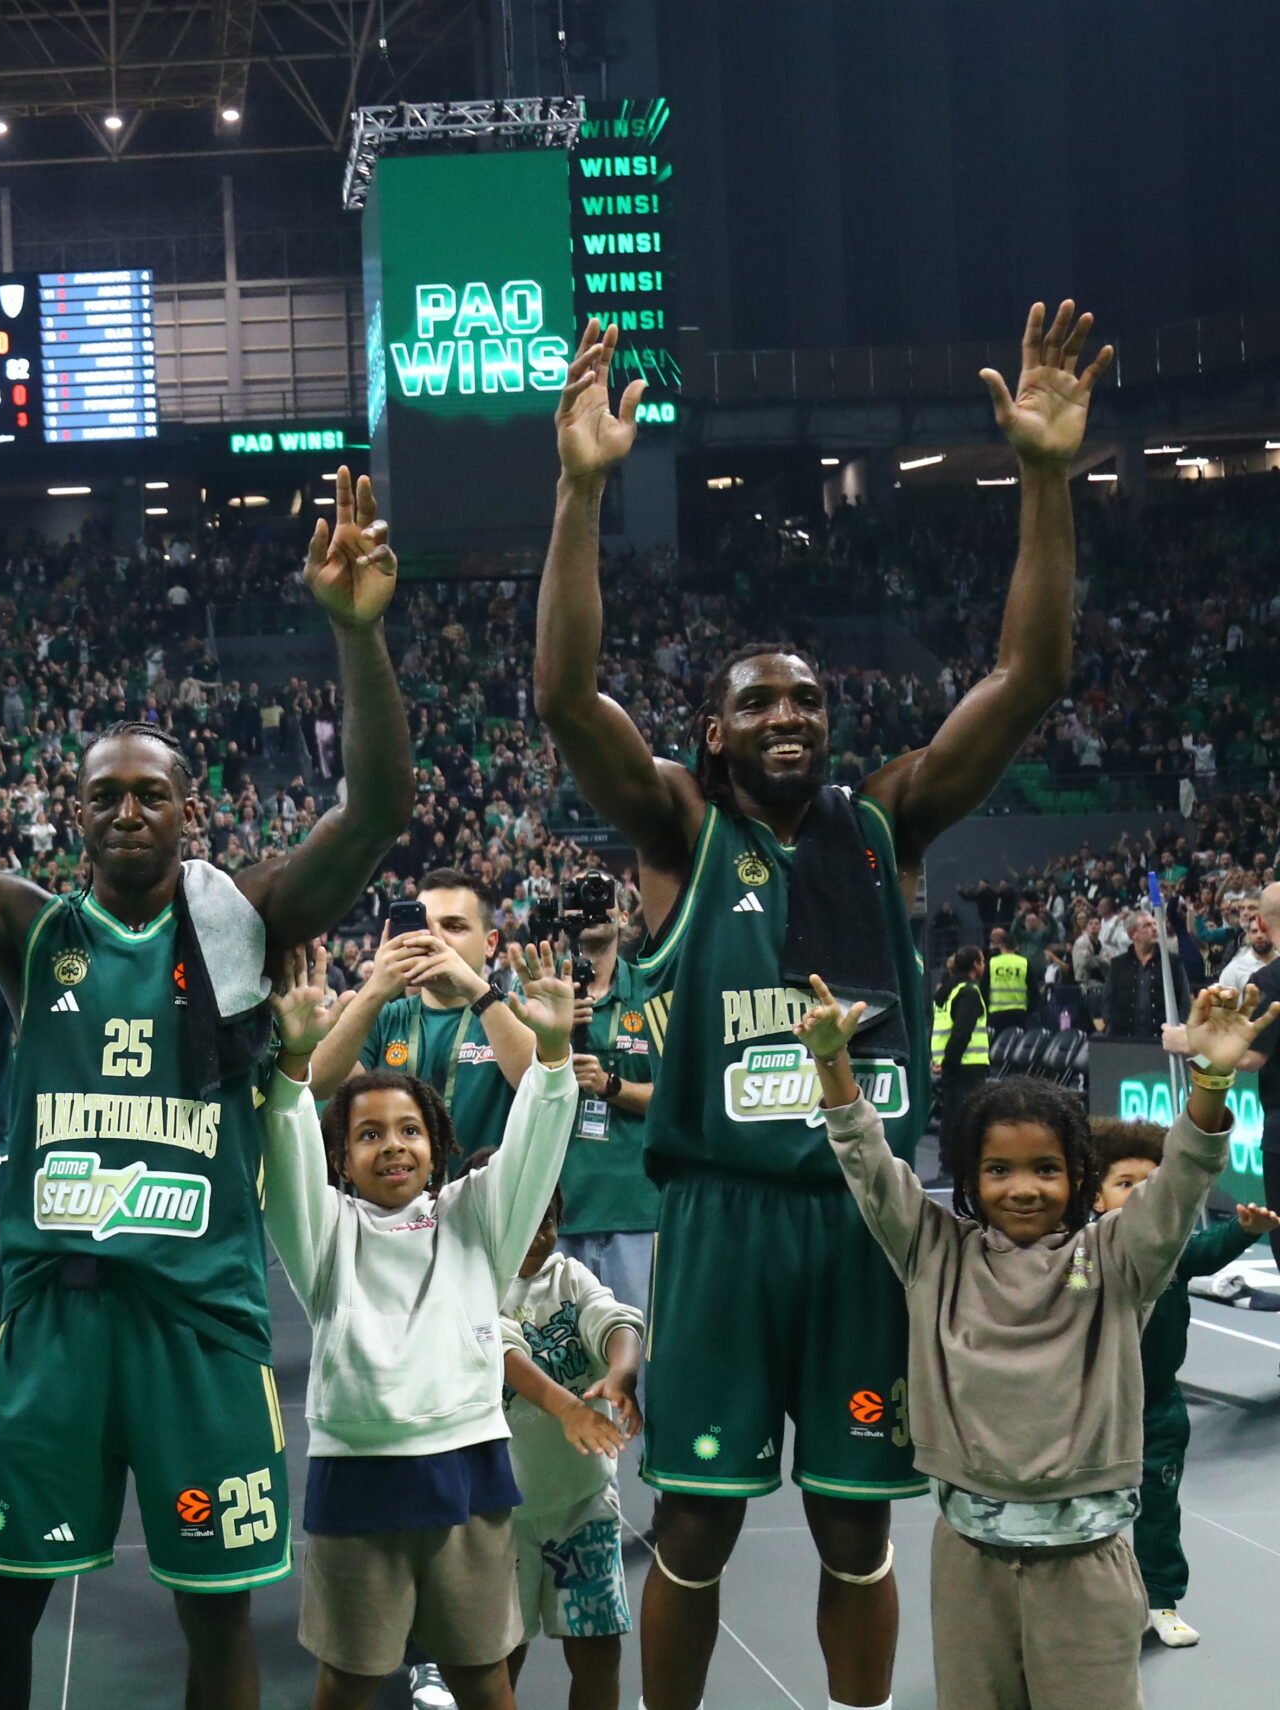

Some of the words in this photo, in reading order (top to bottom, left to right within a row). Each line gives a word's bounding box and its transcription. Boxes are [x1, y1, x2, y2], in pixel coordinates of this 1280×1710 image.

[580, 156, 657, 177] WINS!
[582, 195, 659, 216] WINS!
[583, 233, 661, 254] WINS!
[585, 271, 662, 293] WINS!
[415, 280, 543, 339] PAO
[587, 310, 664, 331] WINS!
[390, 336, 569, 397] WINS
[12, 384, 27, 406] 0
[634, 403, 675, 423] PAO
[231, 433, 273, 454] PAO
[279, 430, 345, 452] WINS!
[996, 967, 1021, 976] CSI
[101, 1017, 153, 1077] 25
[751, 1052, 795, 1070] pame
[35, 1092, 222, 1159] PANATHINAIKOS
[47, 1160, 89, 1177] pame
[710, 1424, 722, 1435] bp
[218, 1467, 278, 1550] 25
